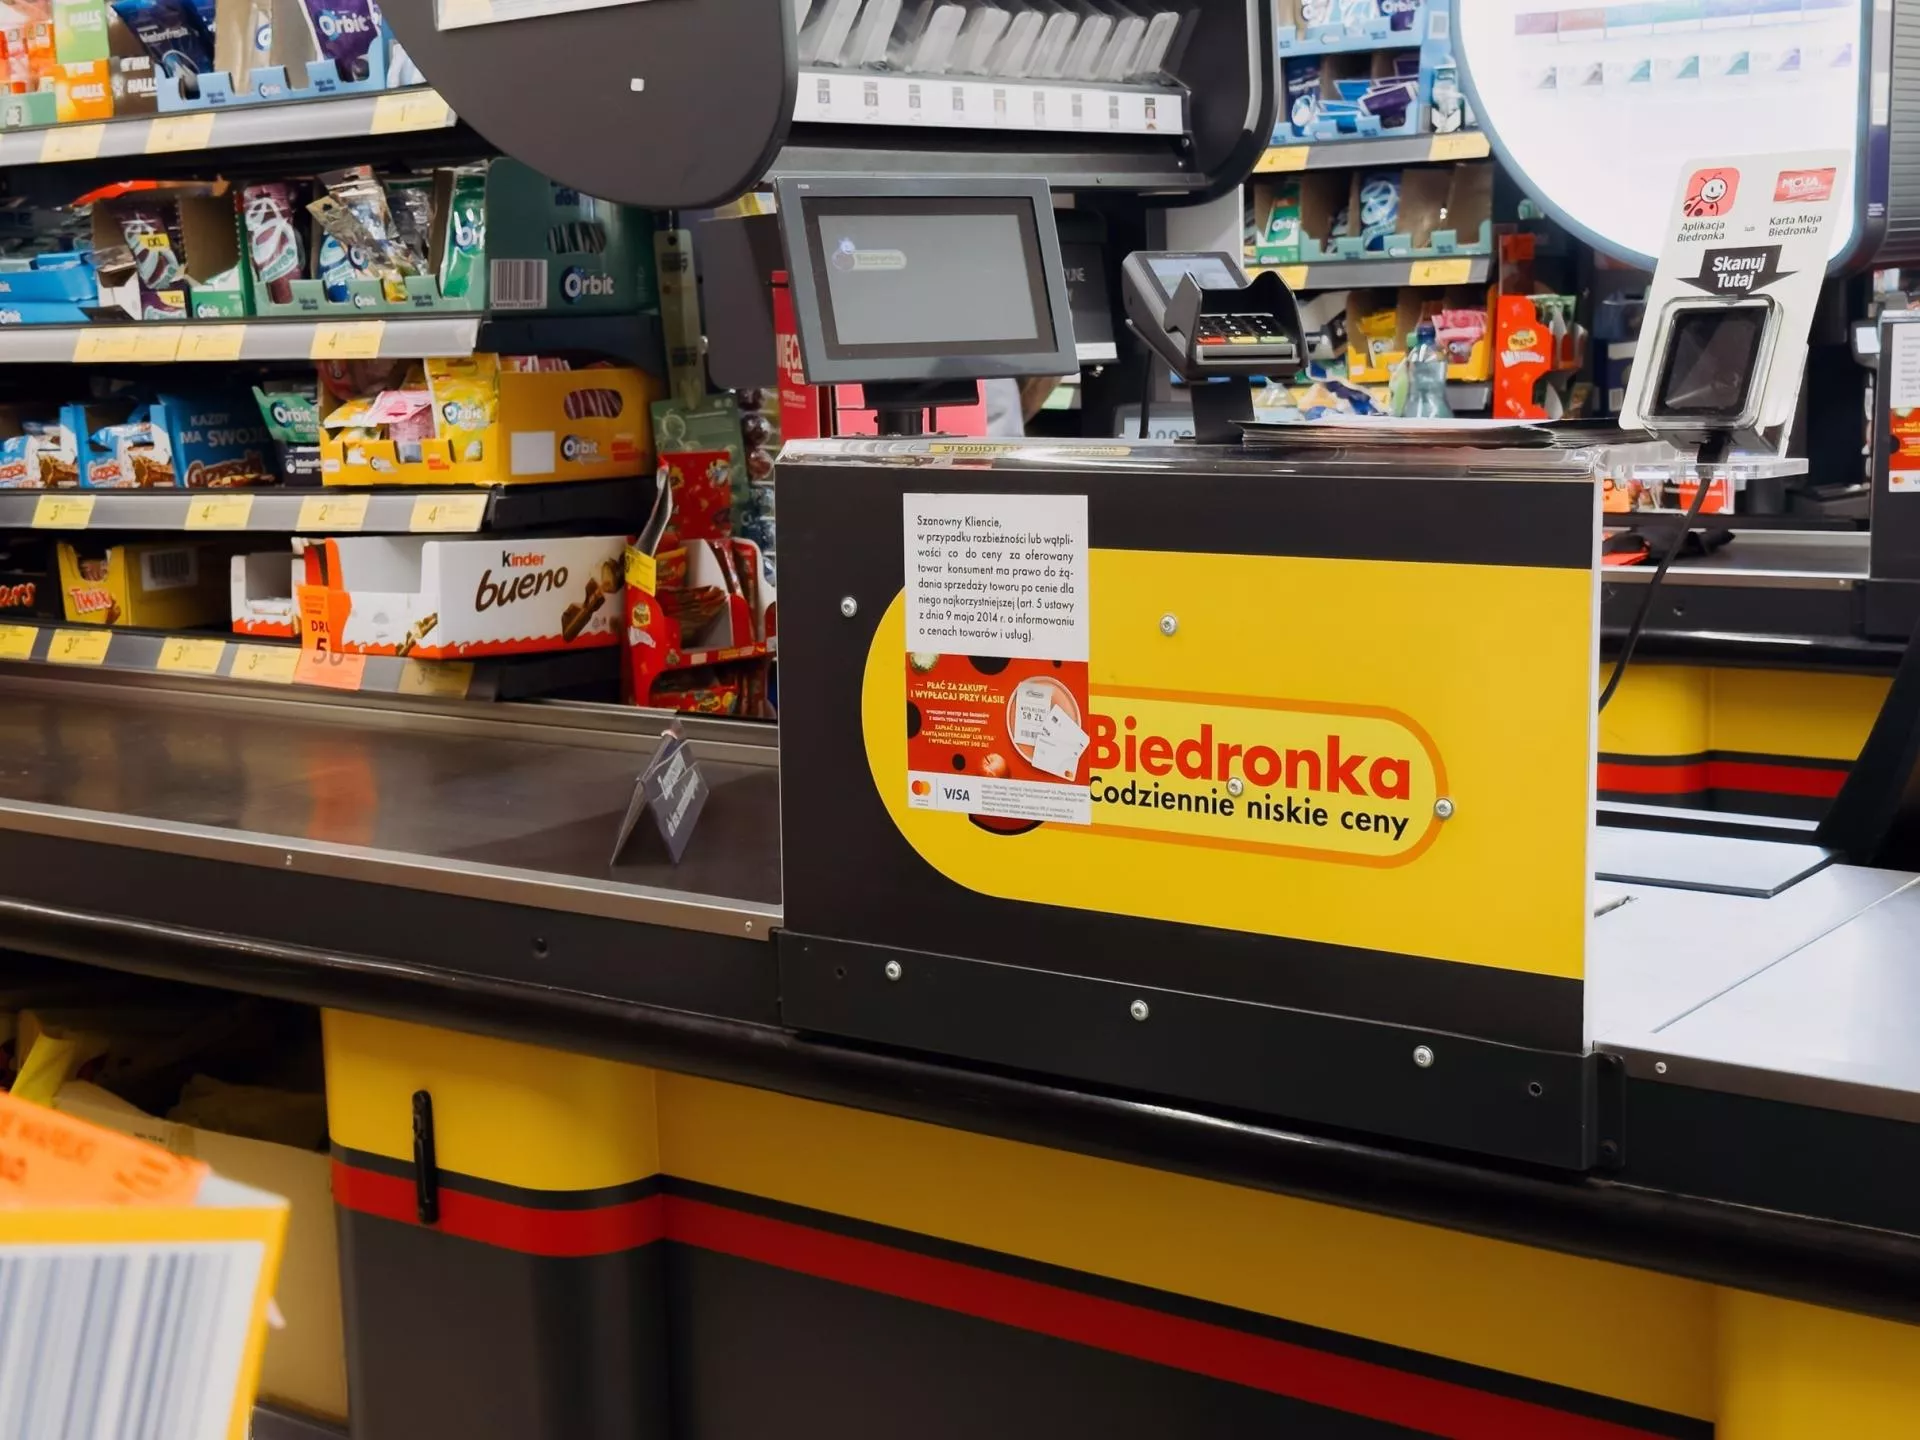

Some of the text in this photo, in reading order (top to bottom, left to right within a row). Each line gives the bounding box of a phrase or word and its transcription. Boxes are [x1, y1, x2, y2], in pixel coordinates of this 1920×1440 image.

[318, 11, 370, 36] Orbit
[1681, 220, 1725, 232] Aplikacja
[1769, 214, 1822, 226] Karta Moja
[1676, 232, 1725, 243] Biedronka
[1768, 225, 1818, 237] Biedronka
[1711, 253, 1767, 273] Skanuj
[564, 272, 615, 298] Orbit
[1716, 272, 1756, 290] Tutaj
[563, 438, 599, 457] Orbit
[917, 515, 1002, 529] Szanowny Kliencie,
[926, 531, 971, 544] przypadku
[973, 532, 1026, 544] rozbieżności
[1028, 532, 1041, 544] lub
[1044, 533, 1073, 547] wątpli-
[501, 551, 546, 570] kinder
[917, 547, 1074, 564] wości co do ceny za oferowany
[918, 562, 1074, 580] towar konsument ma prawo do żą-
[475, 566, 569, 613] bueno
[918, 577, 1074, 595] dania sprzedaży towaru po cenie dla
[918, 594, 1074, 613] niego najkorzystniejszej (art. 5 ustawy
[919, 609, 1074, 626] z dnia 9 maja 2014 r. o informowaniu
[927, 625, 957, 636] cenach
[959, 628, 998, 638] towarów
[1005, 628, 1034, 643] usług).
[926, 680, 988, 692] PŁAĆ ZA ZAKUPY
[910, 690, 1005, 704] I WYPŁACAJ PRZY KASIE
[1088, 713, 1411, 800] Biedronka
[943, 787, 970, 801] VISA
[1090, 775, 1235, 817] Codziennie
[1247, 793, 1329, 826] niskie
[1340, 810, 1410, 841] ceny
